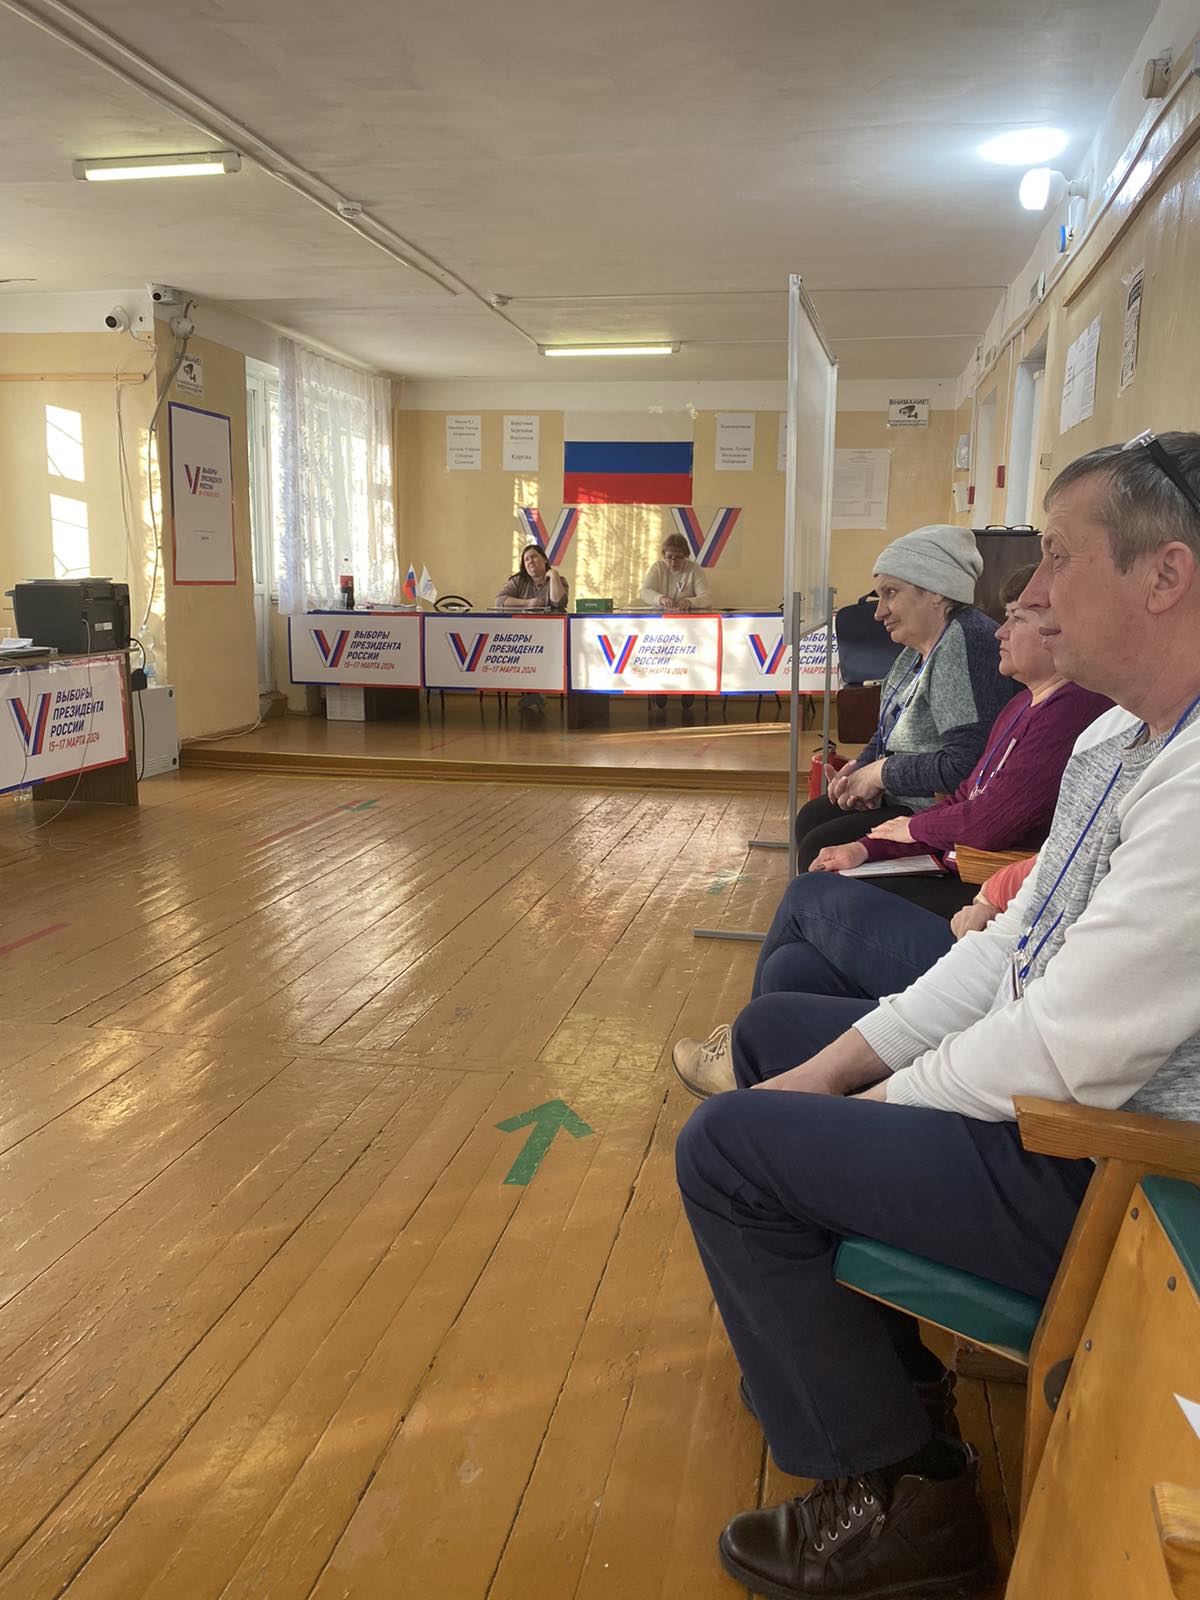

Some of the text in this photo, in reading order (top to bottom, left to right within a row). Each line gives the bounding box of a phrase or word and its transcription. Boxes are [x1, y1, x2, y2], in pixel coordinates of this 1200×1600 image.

[354, 630, 391, 639] ВЫБОРЫ
[493, 633, 533, 643] ВЫБОРЫ
[643, 634, 685, 643] ВЫБОРЫ
[350, 641, 401, 651] ПРЕЗИДЕНТА
[489, 644, 544, 654] ПРЕЗИДЕНТА
[346, 651, 380, 660] РОССИИ
[638, 646, 696, 656] ПРЕЗИДЕНТА
[484, 655, 520, 664] РОССИИ
[633, 656, 671, 665] РОССИИ
[787, 656, 826, 664] РССИИ
[380, 662, 395, 670] 2024
[521, 666, 537, 674] 2024
[56, 687, 93, 704] ВЫБОРЫ
[52, 701, 104, 720] ПРЕЗИДЕНТА
[50, 720, 85, 738] РОССИИ
[66, 735, 85, 748] МАРТА
[86, 732, 100, 745] 2024
